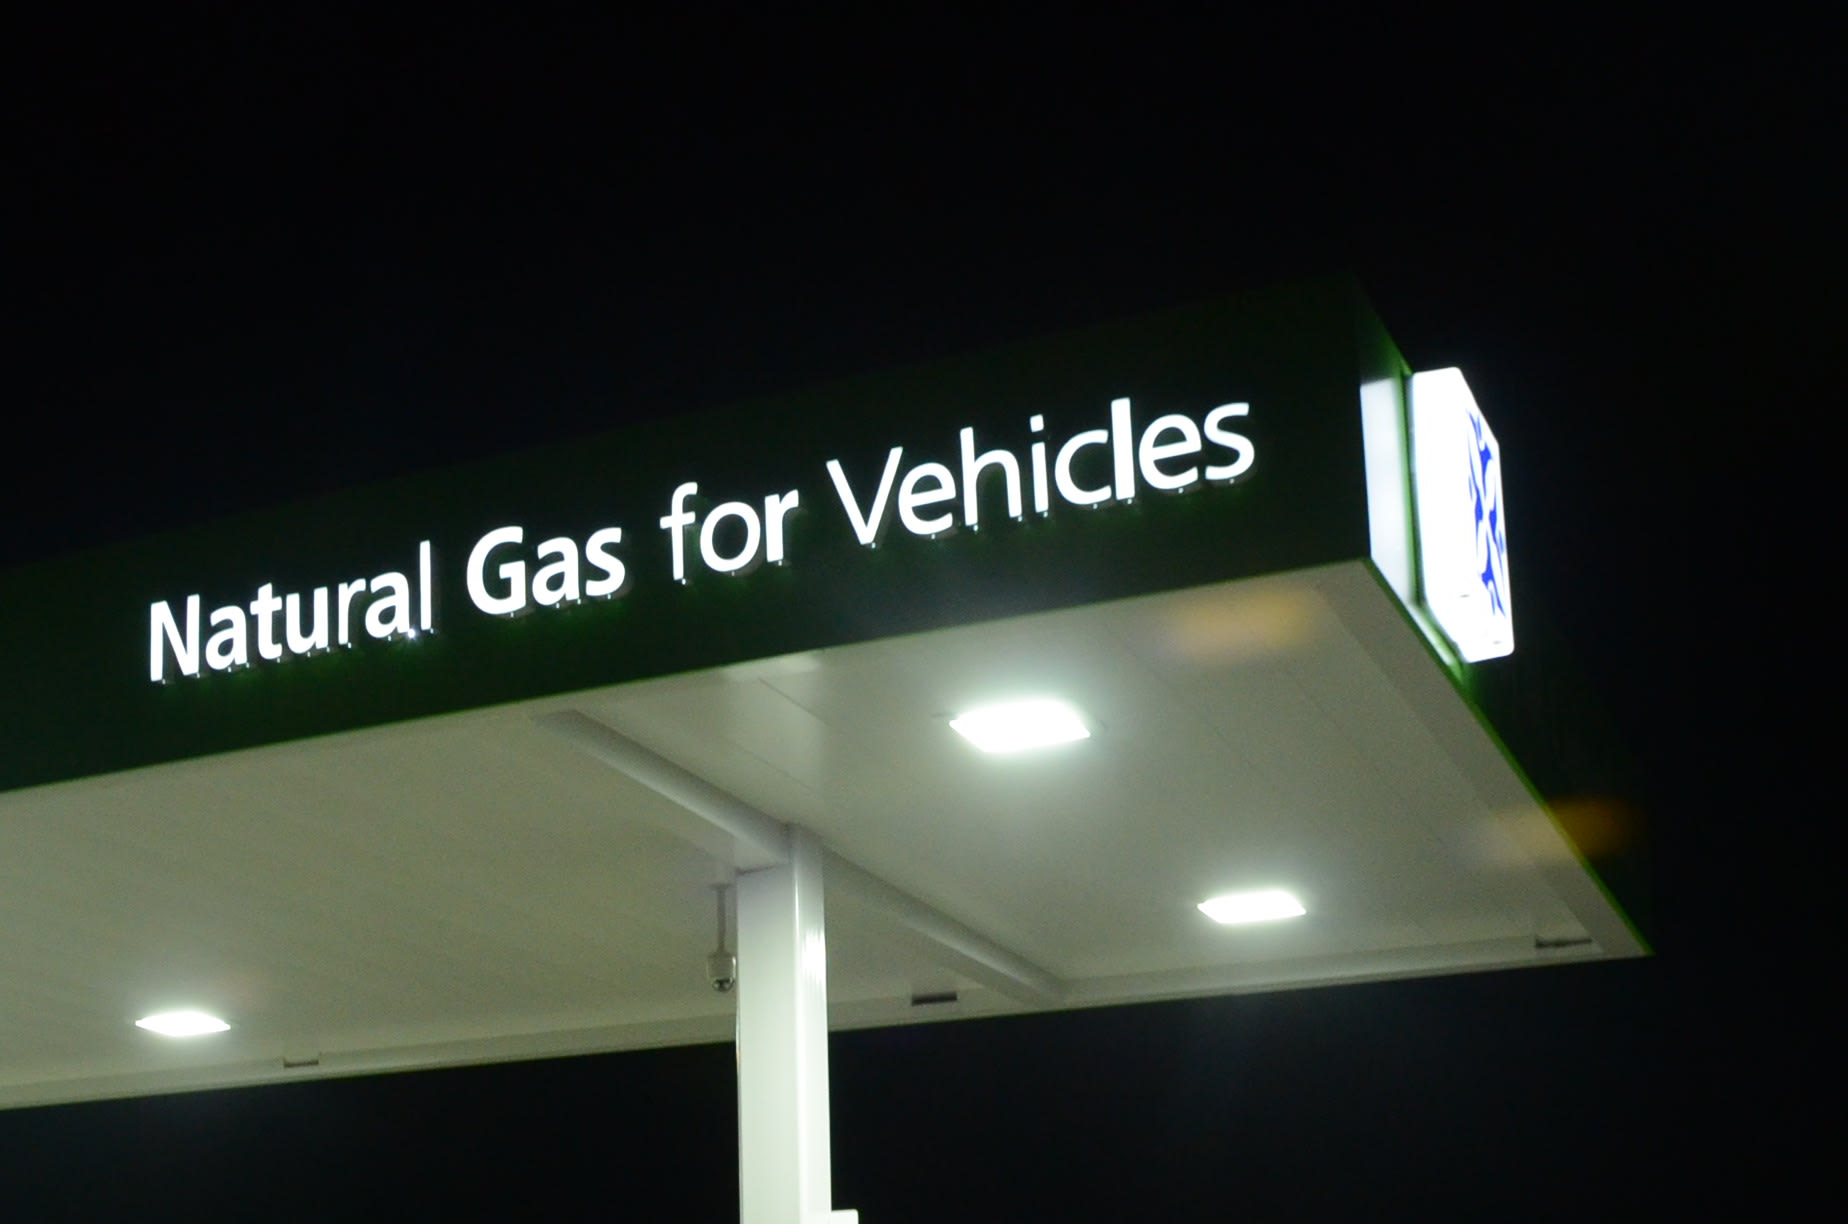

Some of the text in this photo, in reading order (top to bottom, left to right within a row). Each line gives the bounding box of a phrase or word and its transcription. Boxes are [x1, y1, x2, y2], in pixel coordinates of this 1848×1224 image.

[150, 397, 1256, 682] Natural Gas for Vehicles
